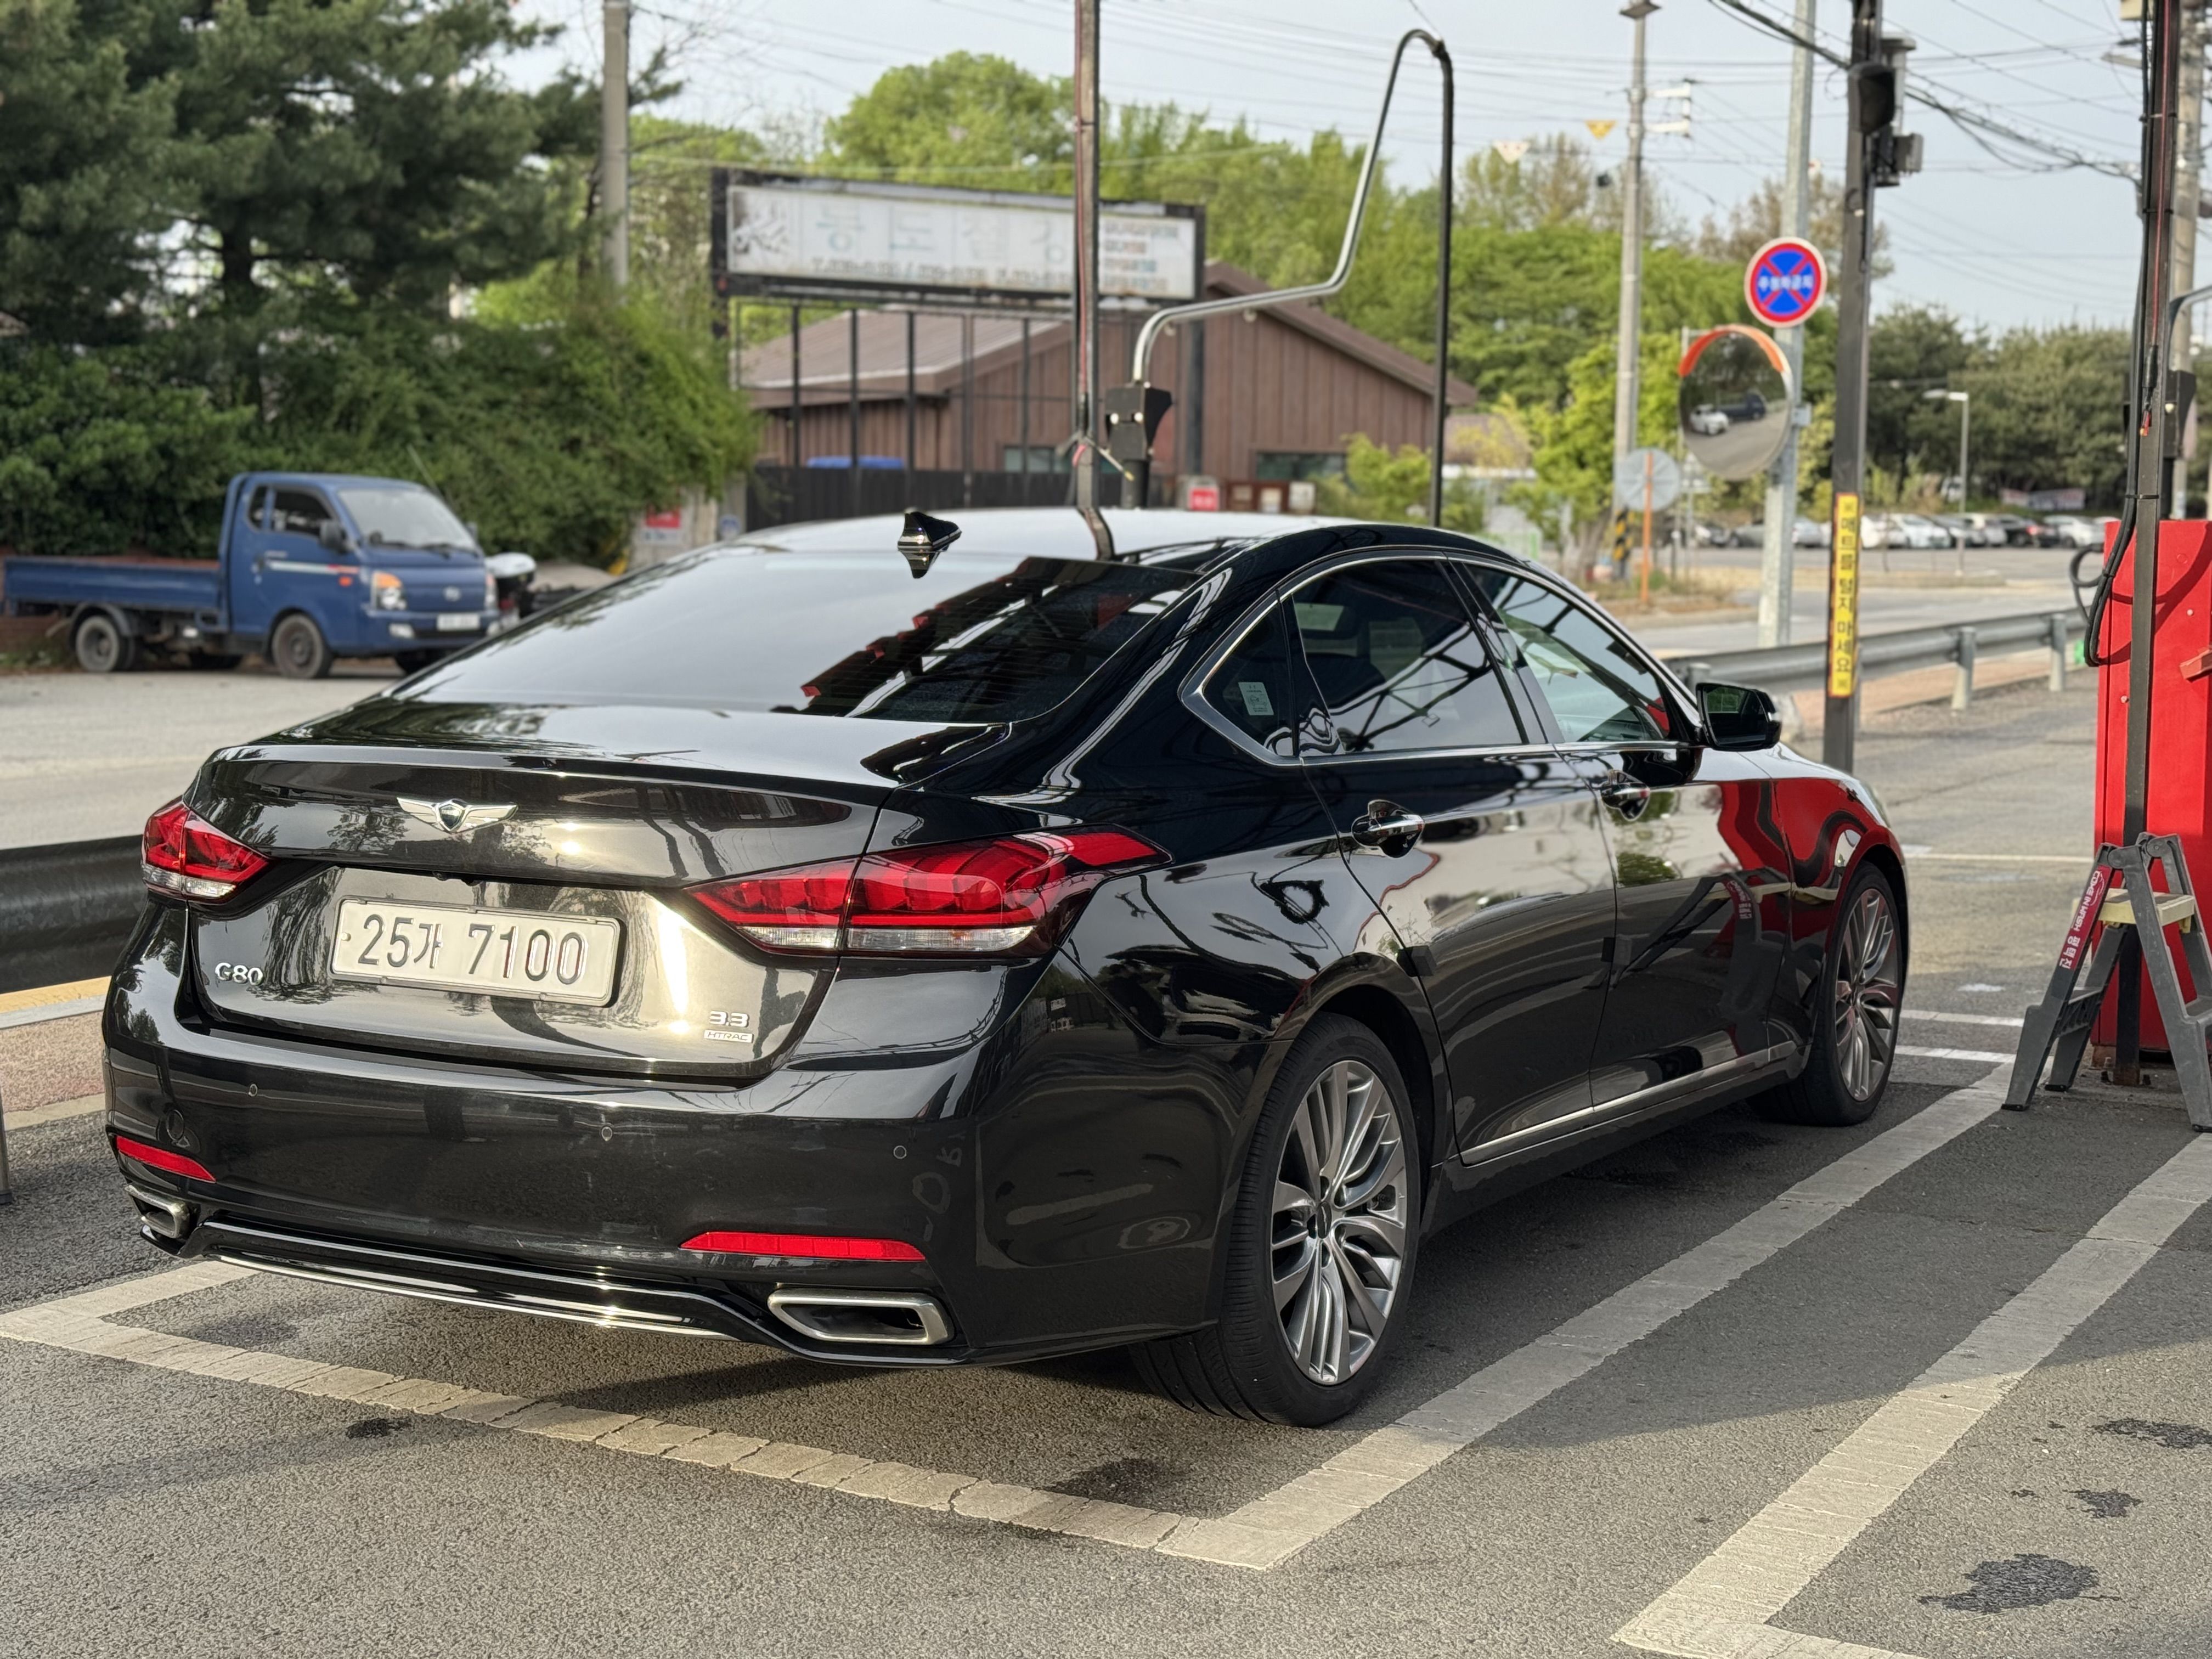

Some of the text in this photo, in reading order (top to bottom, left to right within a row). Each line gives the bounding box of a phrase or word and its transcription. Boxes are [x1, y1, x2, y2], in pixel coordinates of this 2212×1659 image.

[1837, 578, 1853, 613] 털지
[1835, 621, 1853, 673] 마세요
[2073, 870, 2100, 932] COME IN WASH
[358, 914, 588, 985] 25가 7100
[215, 962, 263, 985] G80
[707, 1031, 749, 1041] HTRAC
[709, 1011, 749, 1028] 3.3
